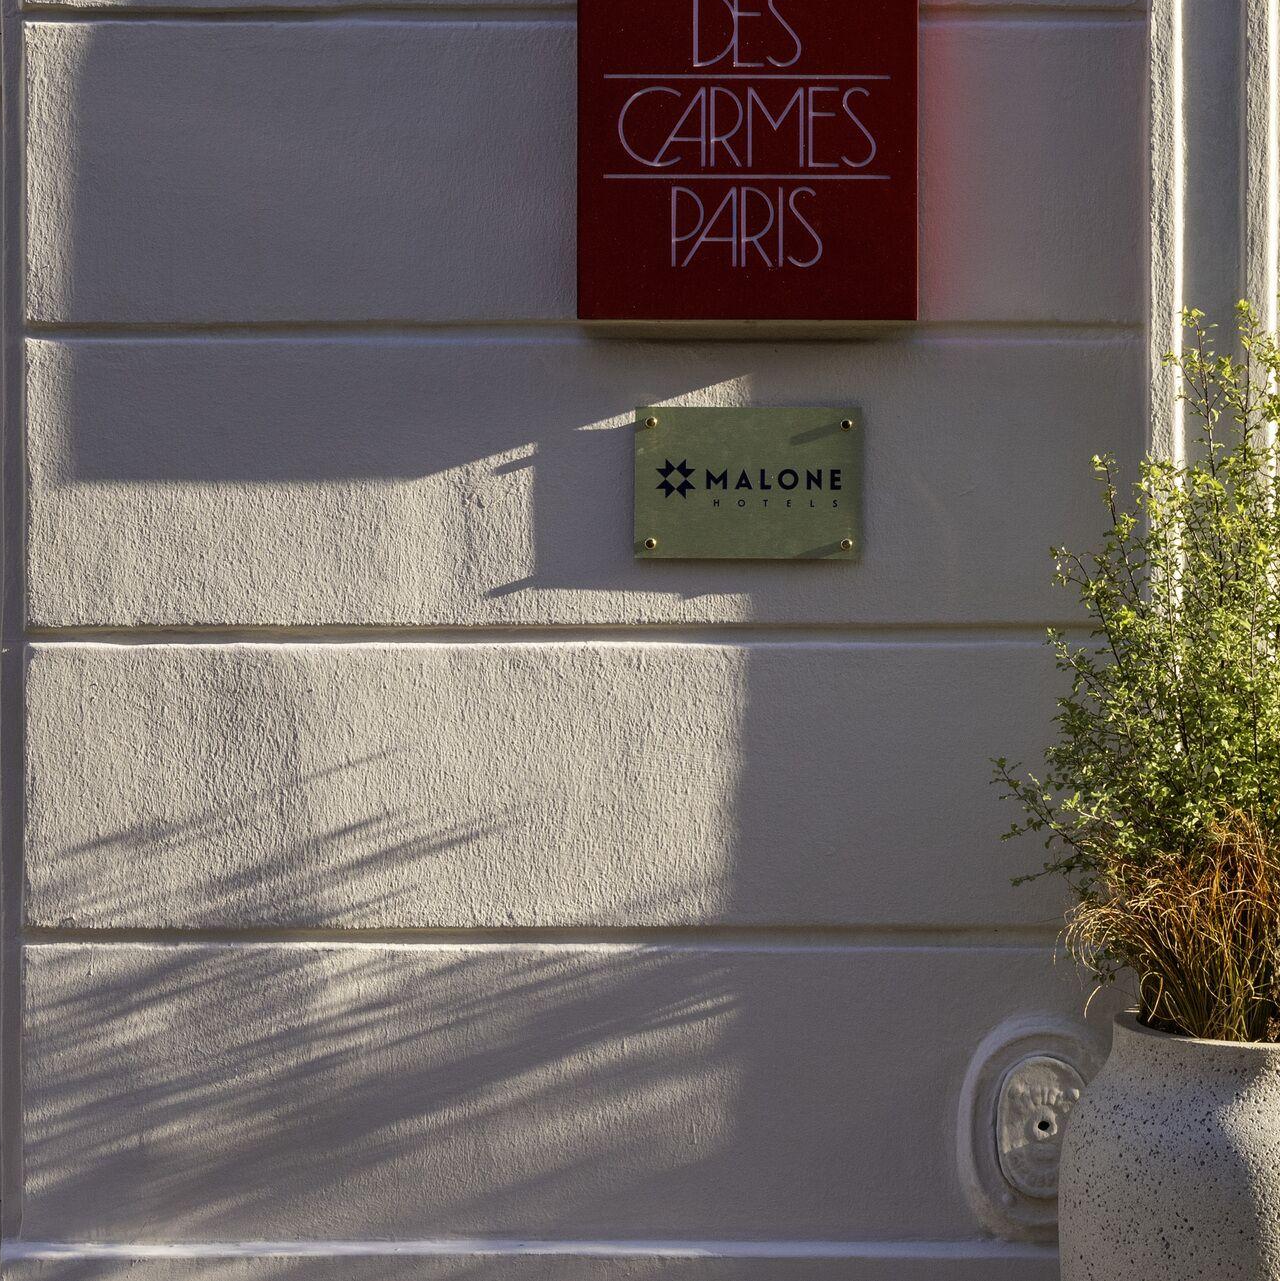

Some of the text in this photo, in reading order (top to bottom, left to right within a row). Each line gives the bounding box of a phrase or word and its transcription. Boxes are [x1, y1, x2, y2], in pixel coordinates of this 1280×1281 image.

[617, 85, 877, 168] CARMES
[670, 185, 823, 268] PARIS
[705, 468, 842, 491] MALONE
[713, 499, 838, 508] HOTELS
